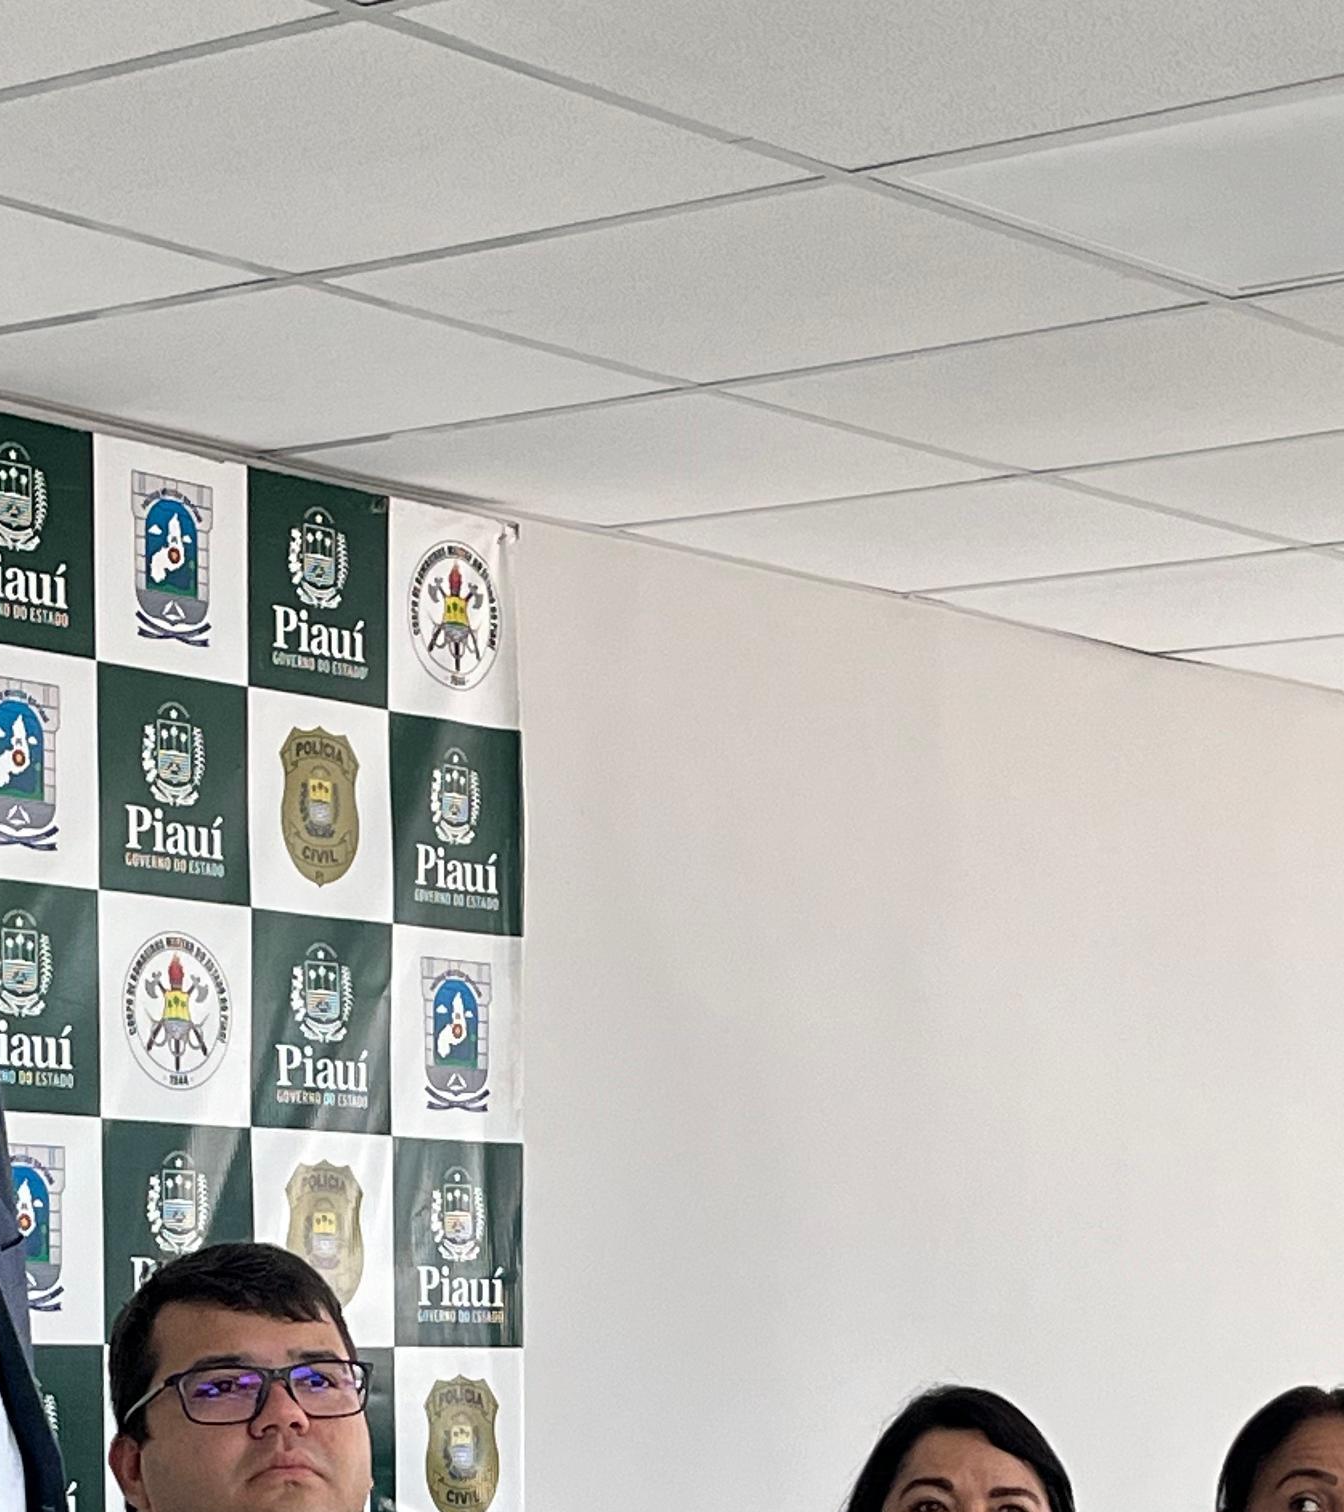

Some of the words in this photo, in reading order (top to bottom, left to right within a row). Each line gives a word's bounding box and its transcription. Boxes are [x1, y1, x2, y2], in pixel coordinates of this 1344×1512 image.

[30, 607, 69, 628] ESTADO
[272, 604, 366, 664] Piauí
[124, 804, 224, 860] Piauí
[302, 846, 339, 863] CIVIL
[415, 843, 498, 894] Piauí
[275, 1044, 368, 1092] Piauí
[417, 1265, 504, 1307] Piauí
[446, 1490, 480, 1504] CIVIL
